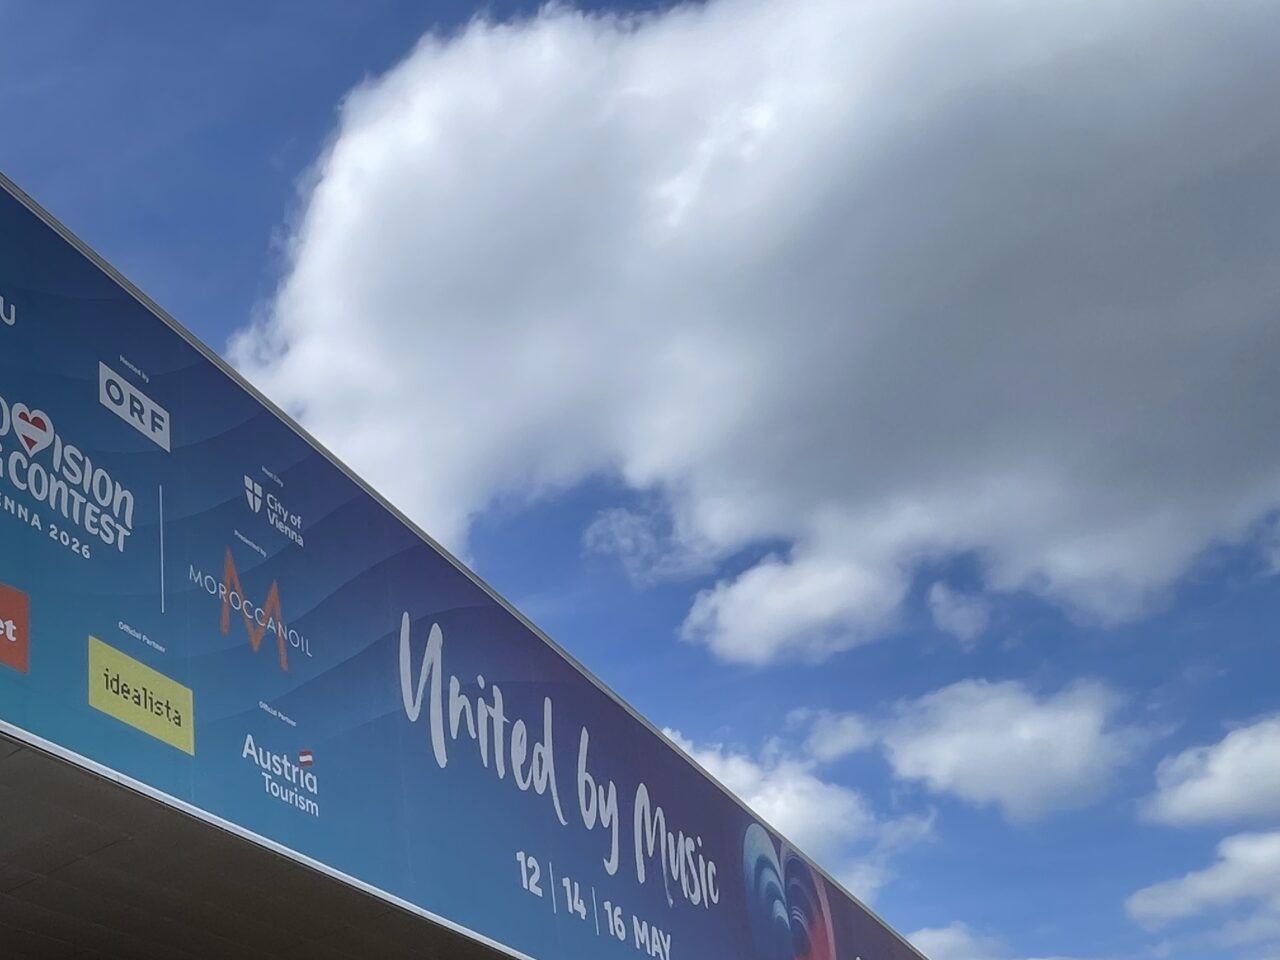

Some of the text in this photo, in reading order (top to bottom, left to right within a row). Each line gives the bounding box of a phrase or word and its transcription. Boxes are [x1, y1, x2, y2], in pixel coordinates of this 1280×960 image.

[105, 378, 165, 433] ORF
[8, 451, 131, 552] CONTEST
[266, 493, 302, 529] City of
[266, 508, 304, 548] Vienna
[49, 524, 91, 559] 2026
[118, 620, 141, 642] Official
[188, 564, 313, 658] MOROCCANOIL
[103, 667, 182, 728] idealista
[242, 733, 318, 795] Austria
[399, 610, 719, 909] United by Music
[261, 771, 319, 817] Tourism
[516, 850, 543, 898] 12
[562, 876, 587, 921] 14
[604, 900, 626, 942] 16
